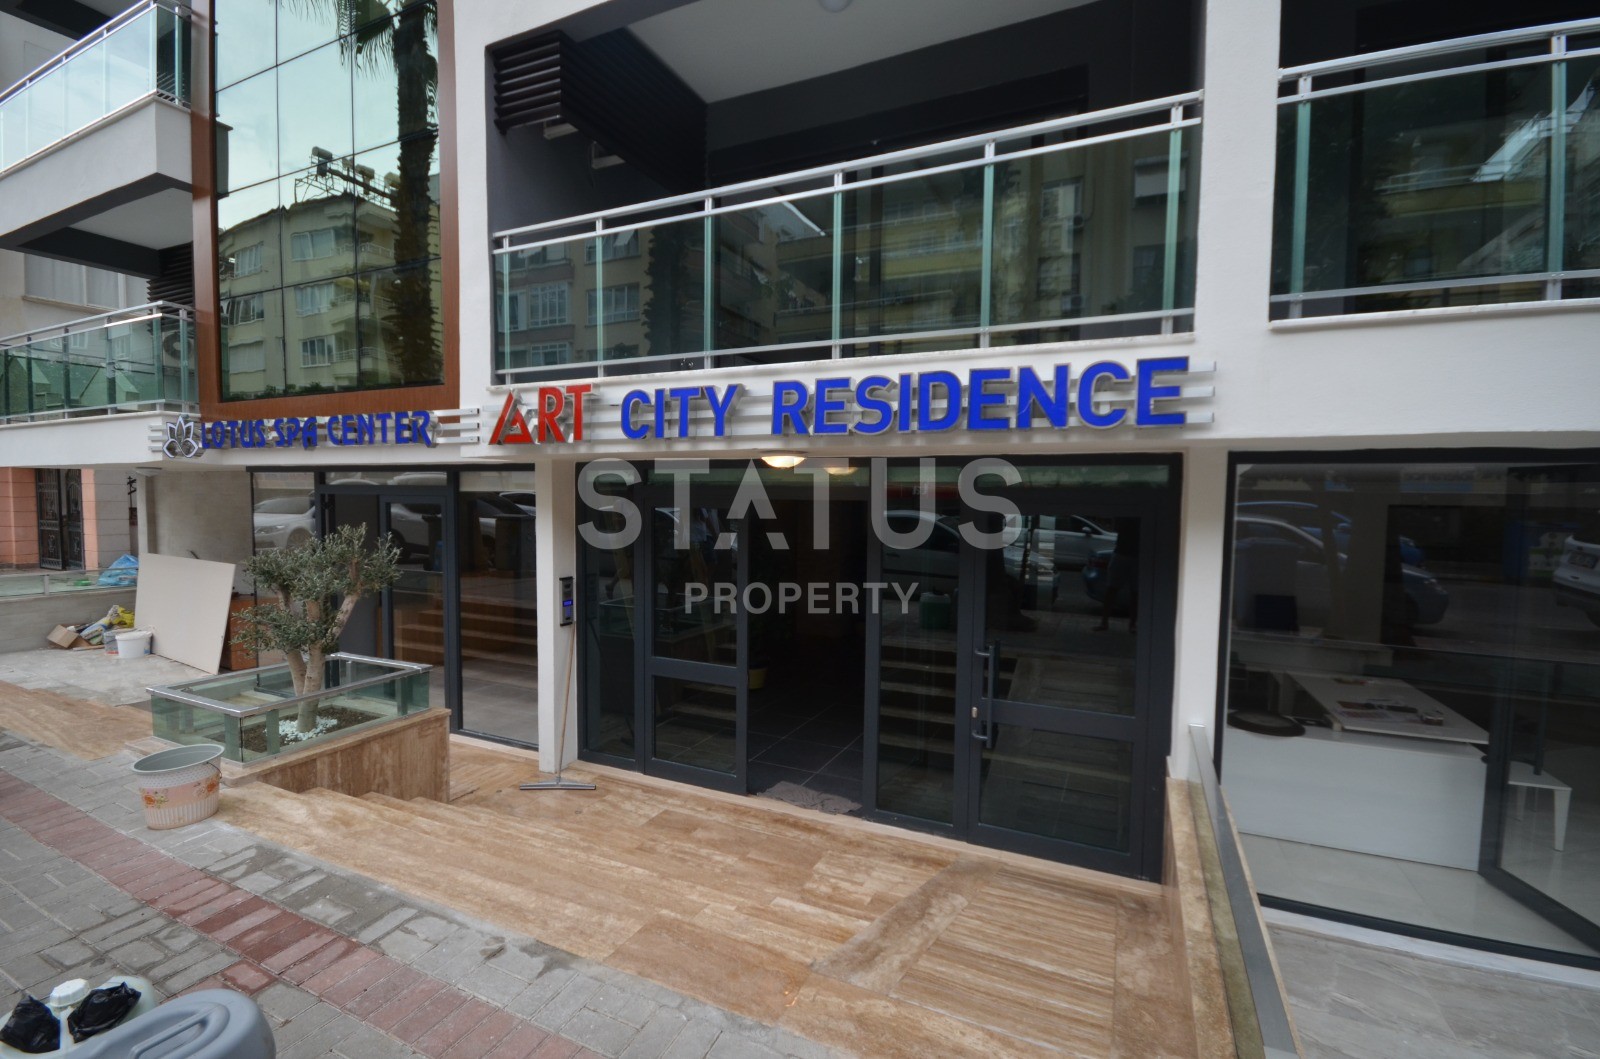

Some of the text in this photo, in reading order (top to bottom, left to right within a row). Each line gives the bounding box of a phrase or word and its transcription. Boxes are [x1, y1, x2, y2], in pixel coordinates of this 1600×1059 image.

[201, 410, 433, 449] LOTUS SPA CENTER
[489, 356, 1190, 445] ART CITY RESIDENCE
